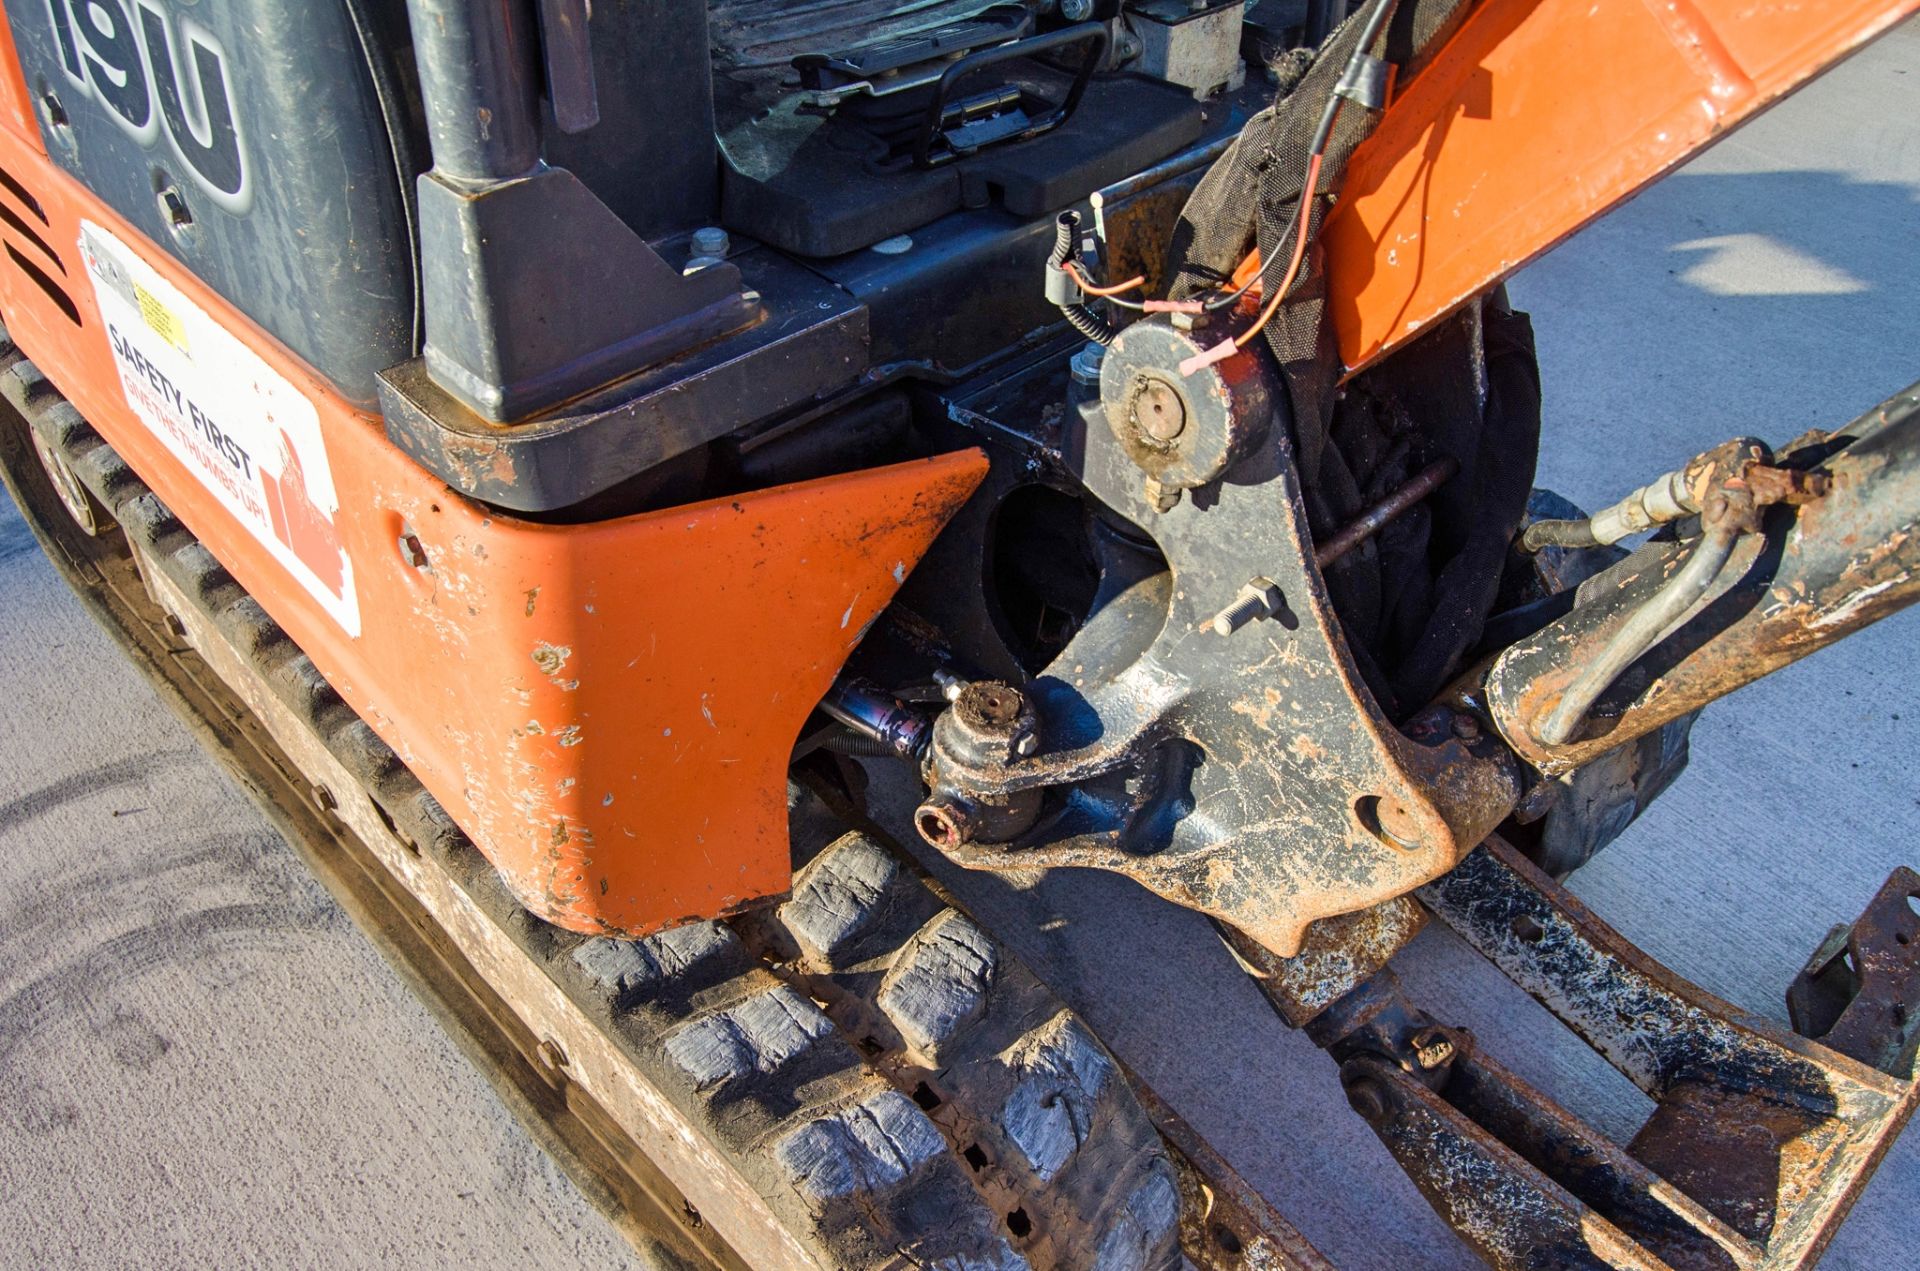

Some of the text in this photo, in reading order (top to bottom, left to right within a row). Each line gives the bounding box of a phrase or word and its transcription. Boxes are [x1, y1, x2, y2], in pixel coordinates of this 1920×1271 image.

[108, 322, 183, 415] SAFETY
[187, 398, 251, 481] FIRST
[124, 373, 268, 528] GIVE THE THUMBS UP!
